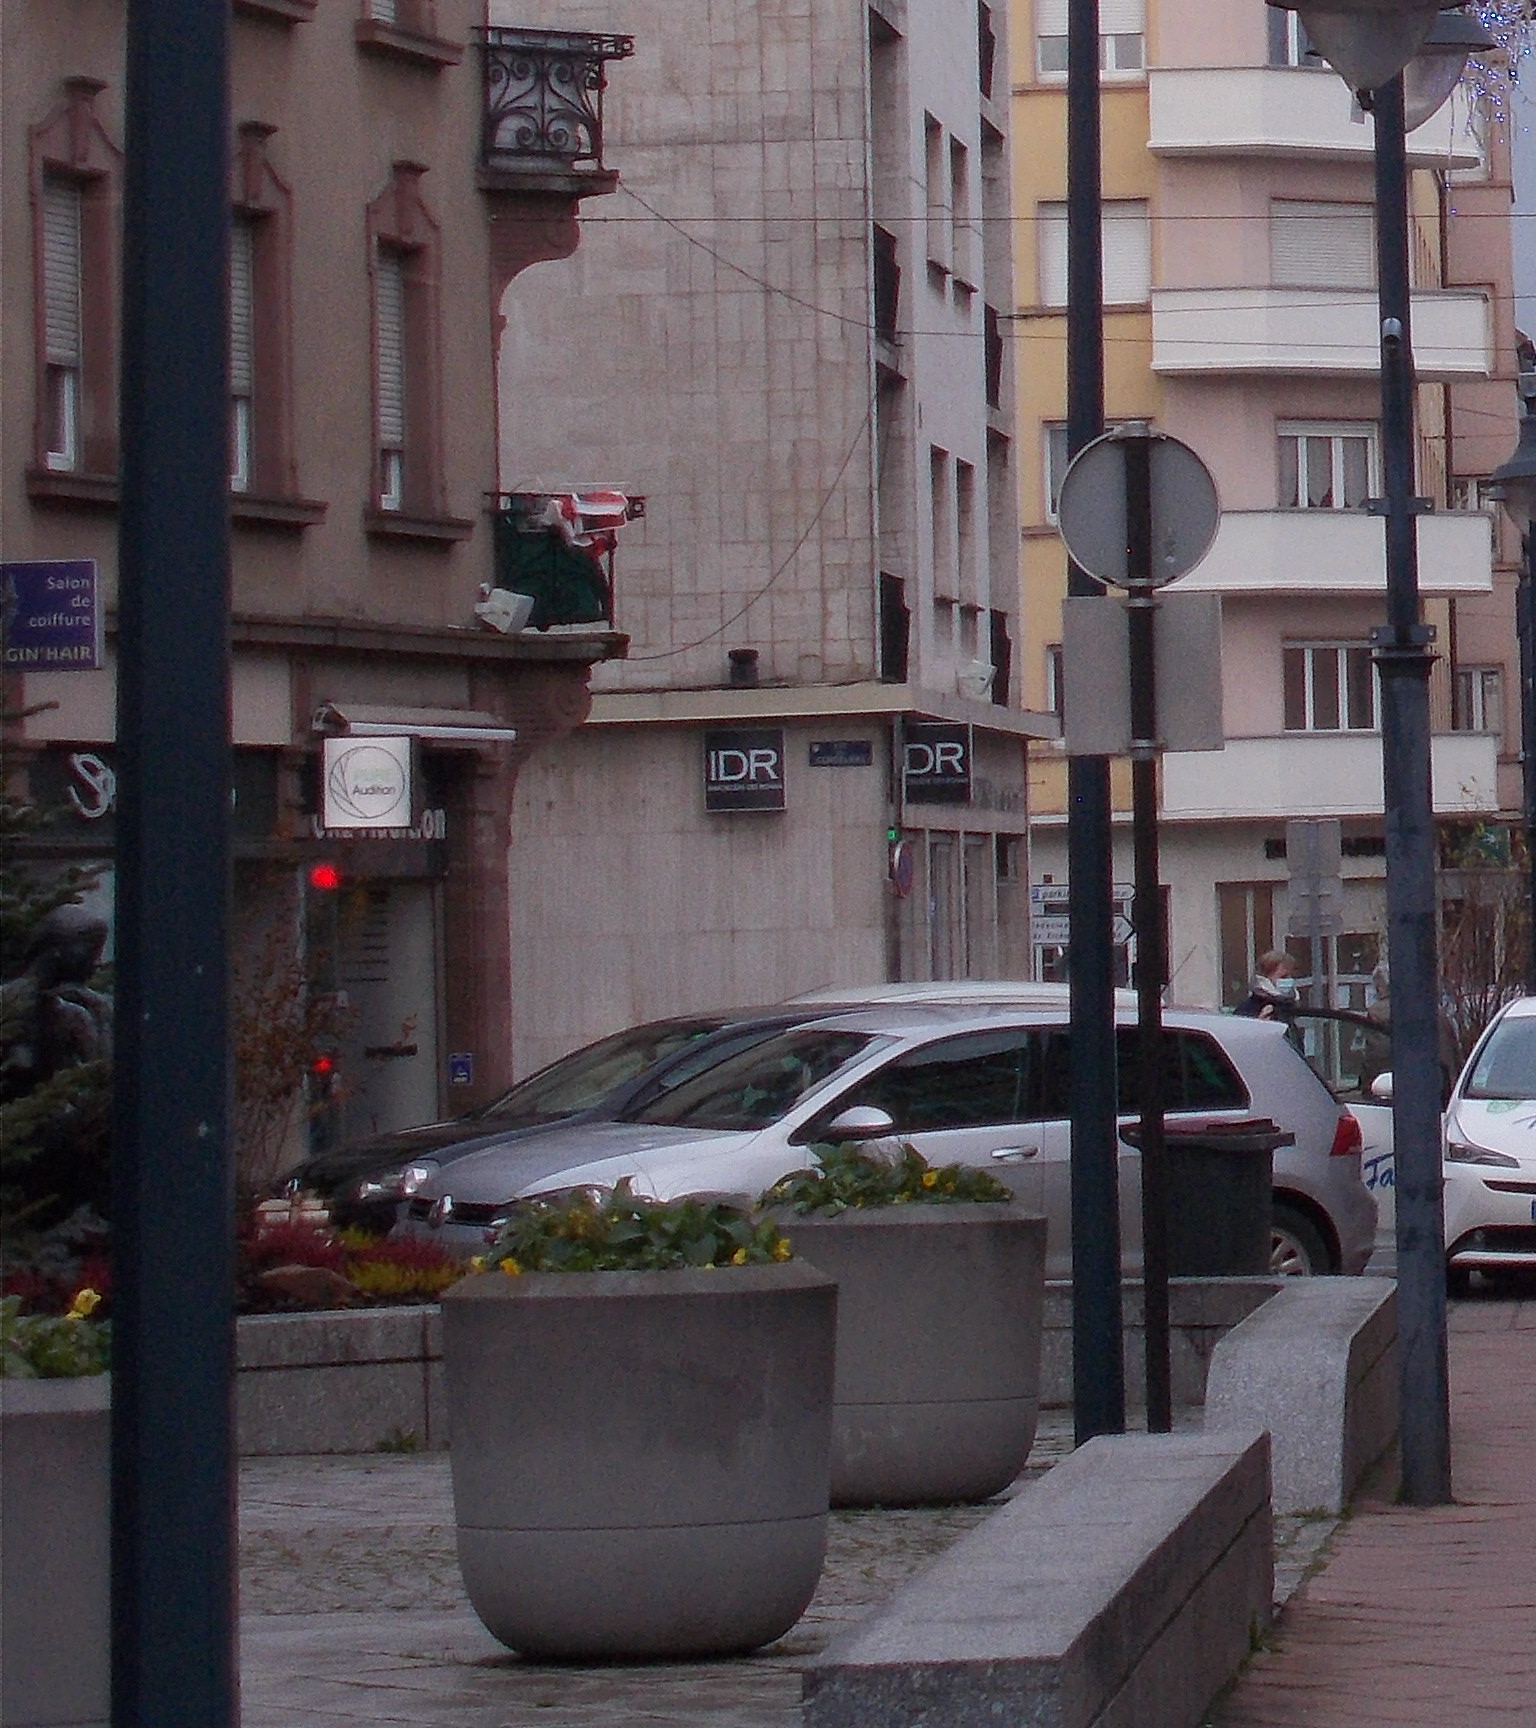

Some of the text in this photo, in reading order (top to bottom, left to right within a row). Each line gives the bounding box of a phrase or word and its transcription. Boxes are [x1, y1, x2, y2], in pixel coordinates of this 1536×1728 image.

[47, 576, 90, 590] Salon
[71, 595, 91, 607] de
[29, 613, 91, 627] coiffure
[709, 748, 779, 782] IDR
[902, 741, 965, 775] DR
